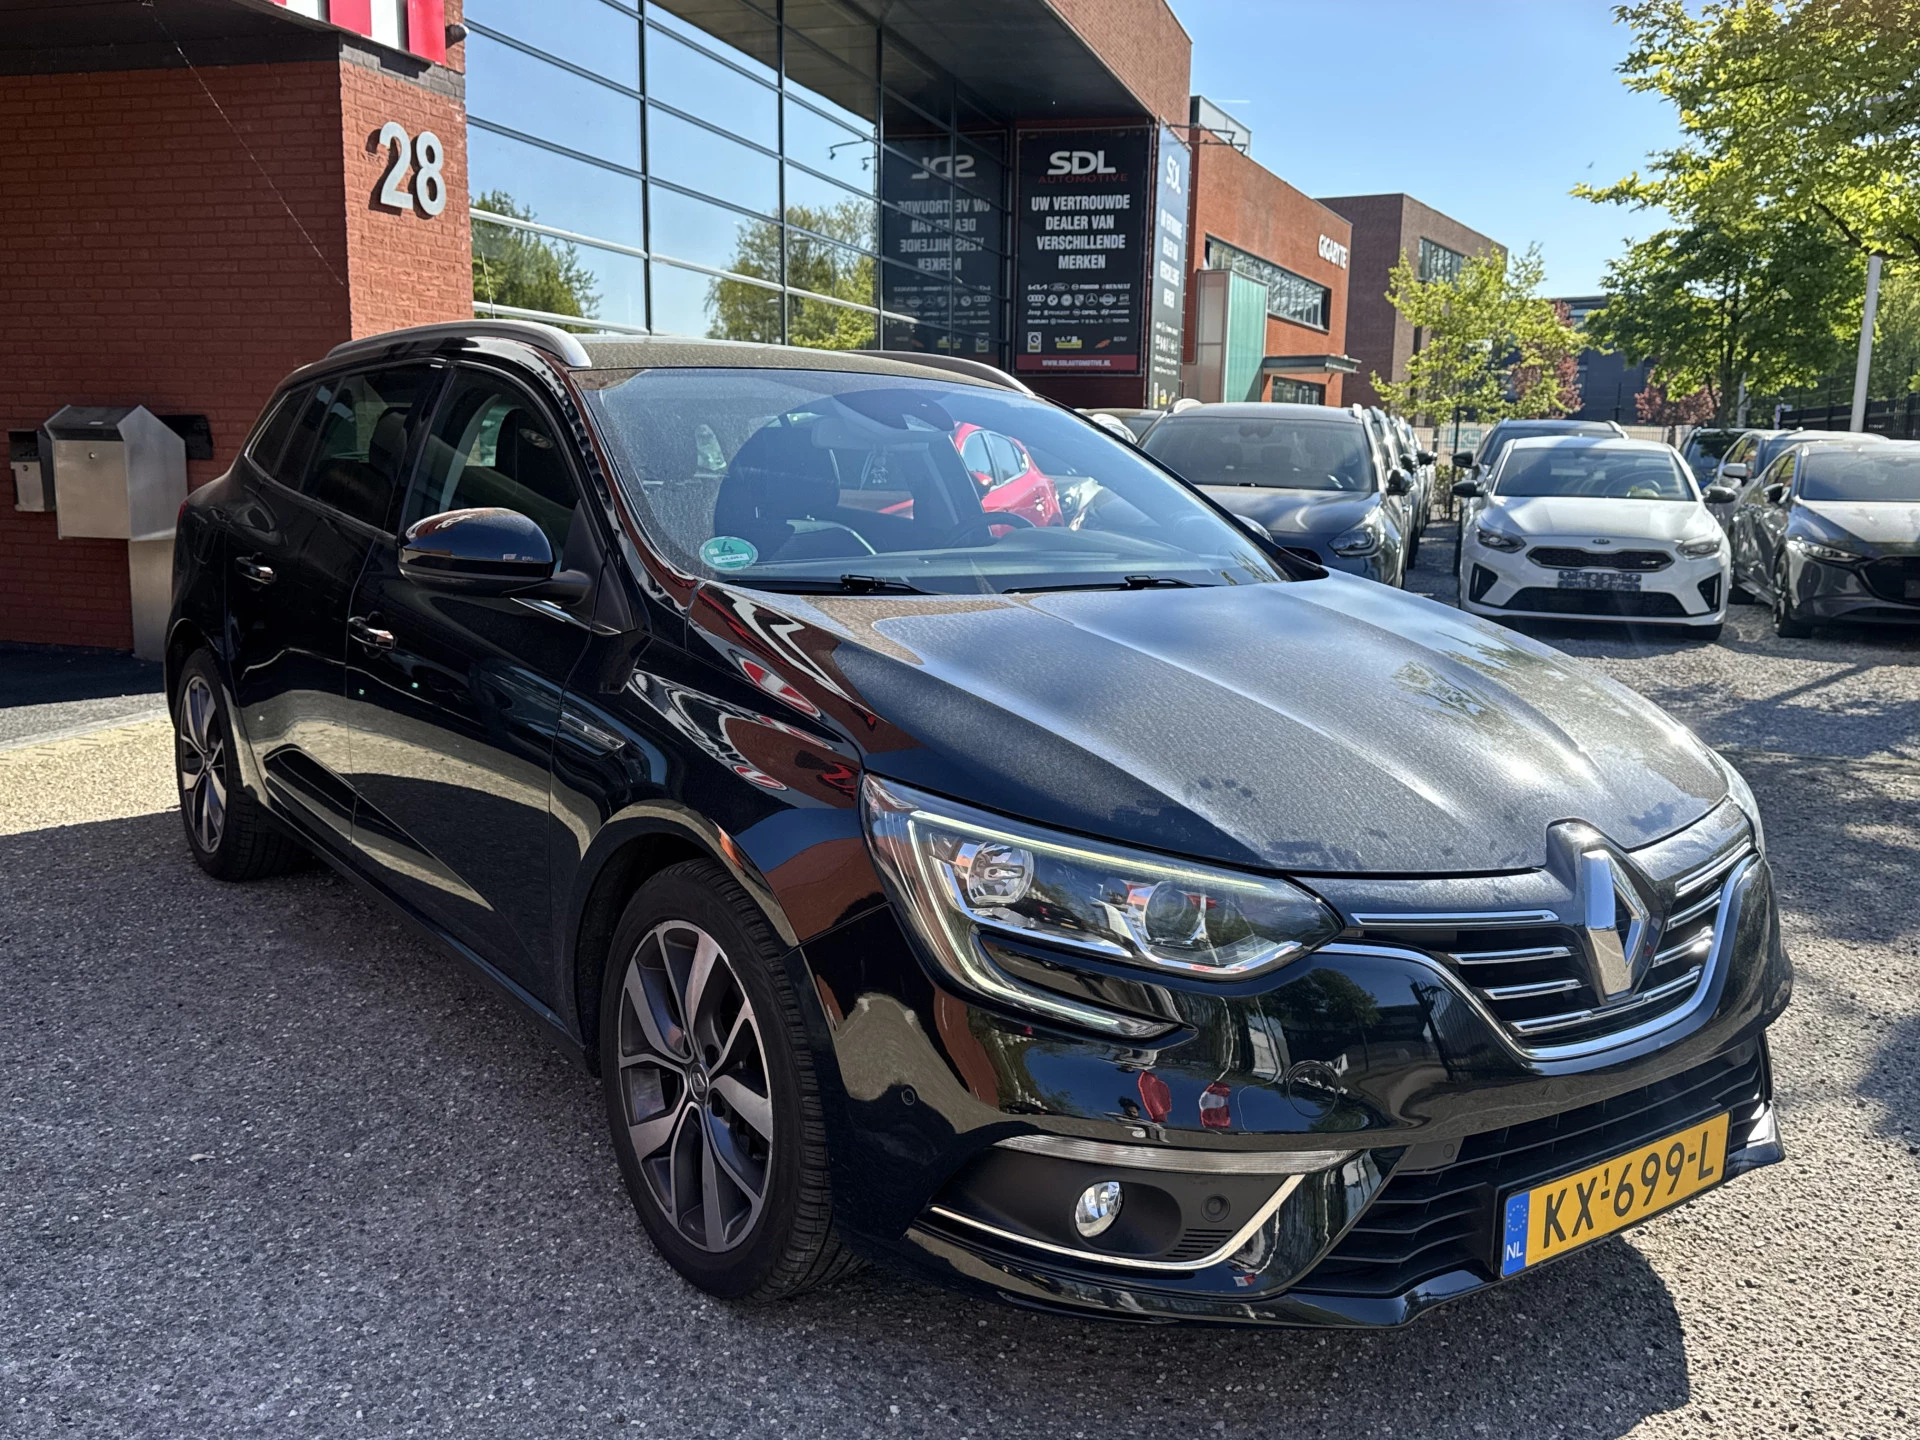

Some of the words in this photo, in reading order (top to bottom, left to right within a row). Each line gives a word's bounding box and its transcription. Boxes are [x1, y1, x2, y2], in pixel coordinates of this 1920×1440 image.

[379, 121, 446, 216] 28
[1047, 150, 1117, 175] SDL
[1038, 173, 1129, 184] AUTOMOTIVE
[1031, 196, 1050, 211] UW
[1052, 194, 1131, 211] VERTROUWDE
[1045, 215, 1089, 231] DEALER
[1091, 214, 1115, 230] VAN
[1036, 234, 1126, 250] VERSCHILLENDE
[1058, 254, 1106, 270] MERKEN
[721, 541, 736, 554] 4
[1506, 1241, 1524, 1262] NL
